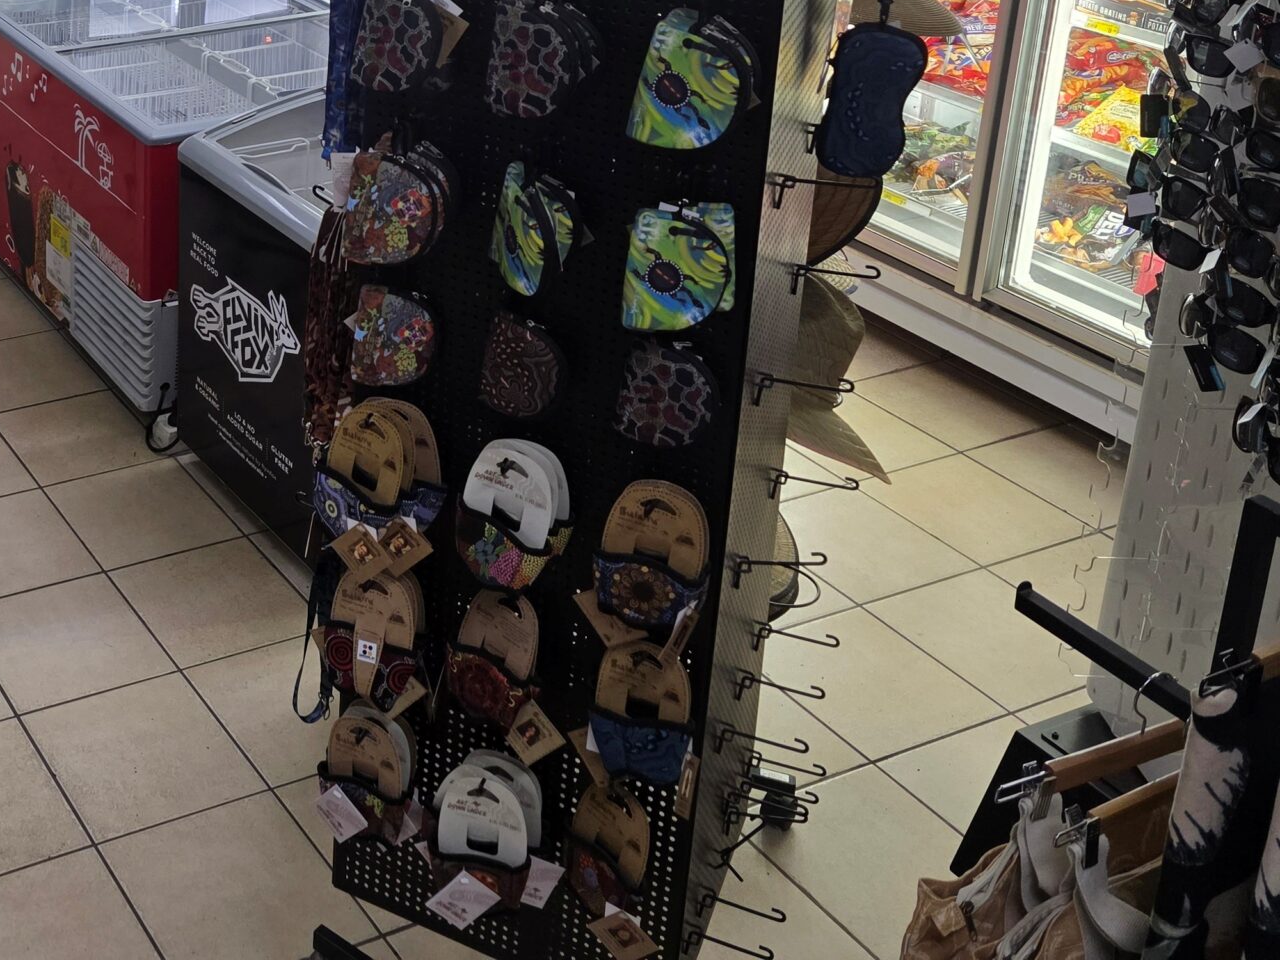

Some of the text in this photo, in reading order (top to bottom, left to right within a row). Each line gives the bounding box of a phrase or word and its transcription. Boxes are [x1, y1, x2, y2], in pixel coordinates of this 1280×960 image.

[1099, 6, 1127, 22] GRATINS
[1147, 21, 1169, 35] POTAT
[191, 231, 217, 257] WELCOME
[192, 242, 216, 266] BACK TO
[190, 249, 219, 278] REAL FOOD
[230, 326, 270, 372] FOX
[226, 413, 245, 433] ADDED
[245, 430, 263, 451] SUGAR
[234, 411, 242, 422] LO
[246, 423, 256, 434] NO
[270, 444, 293, 469] GLUTEN
[274, 457, 289, 475] FREE
[483, 468, 498, 479] ART
